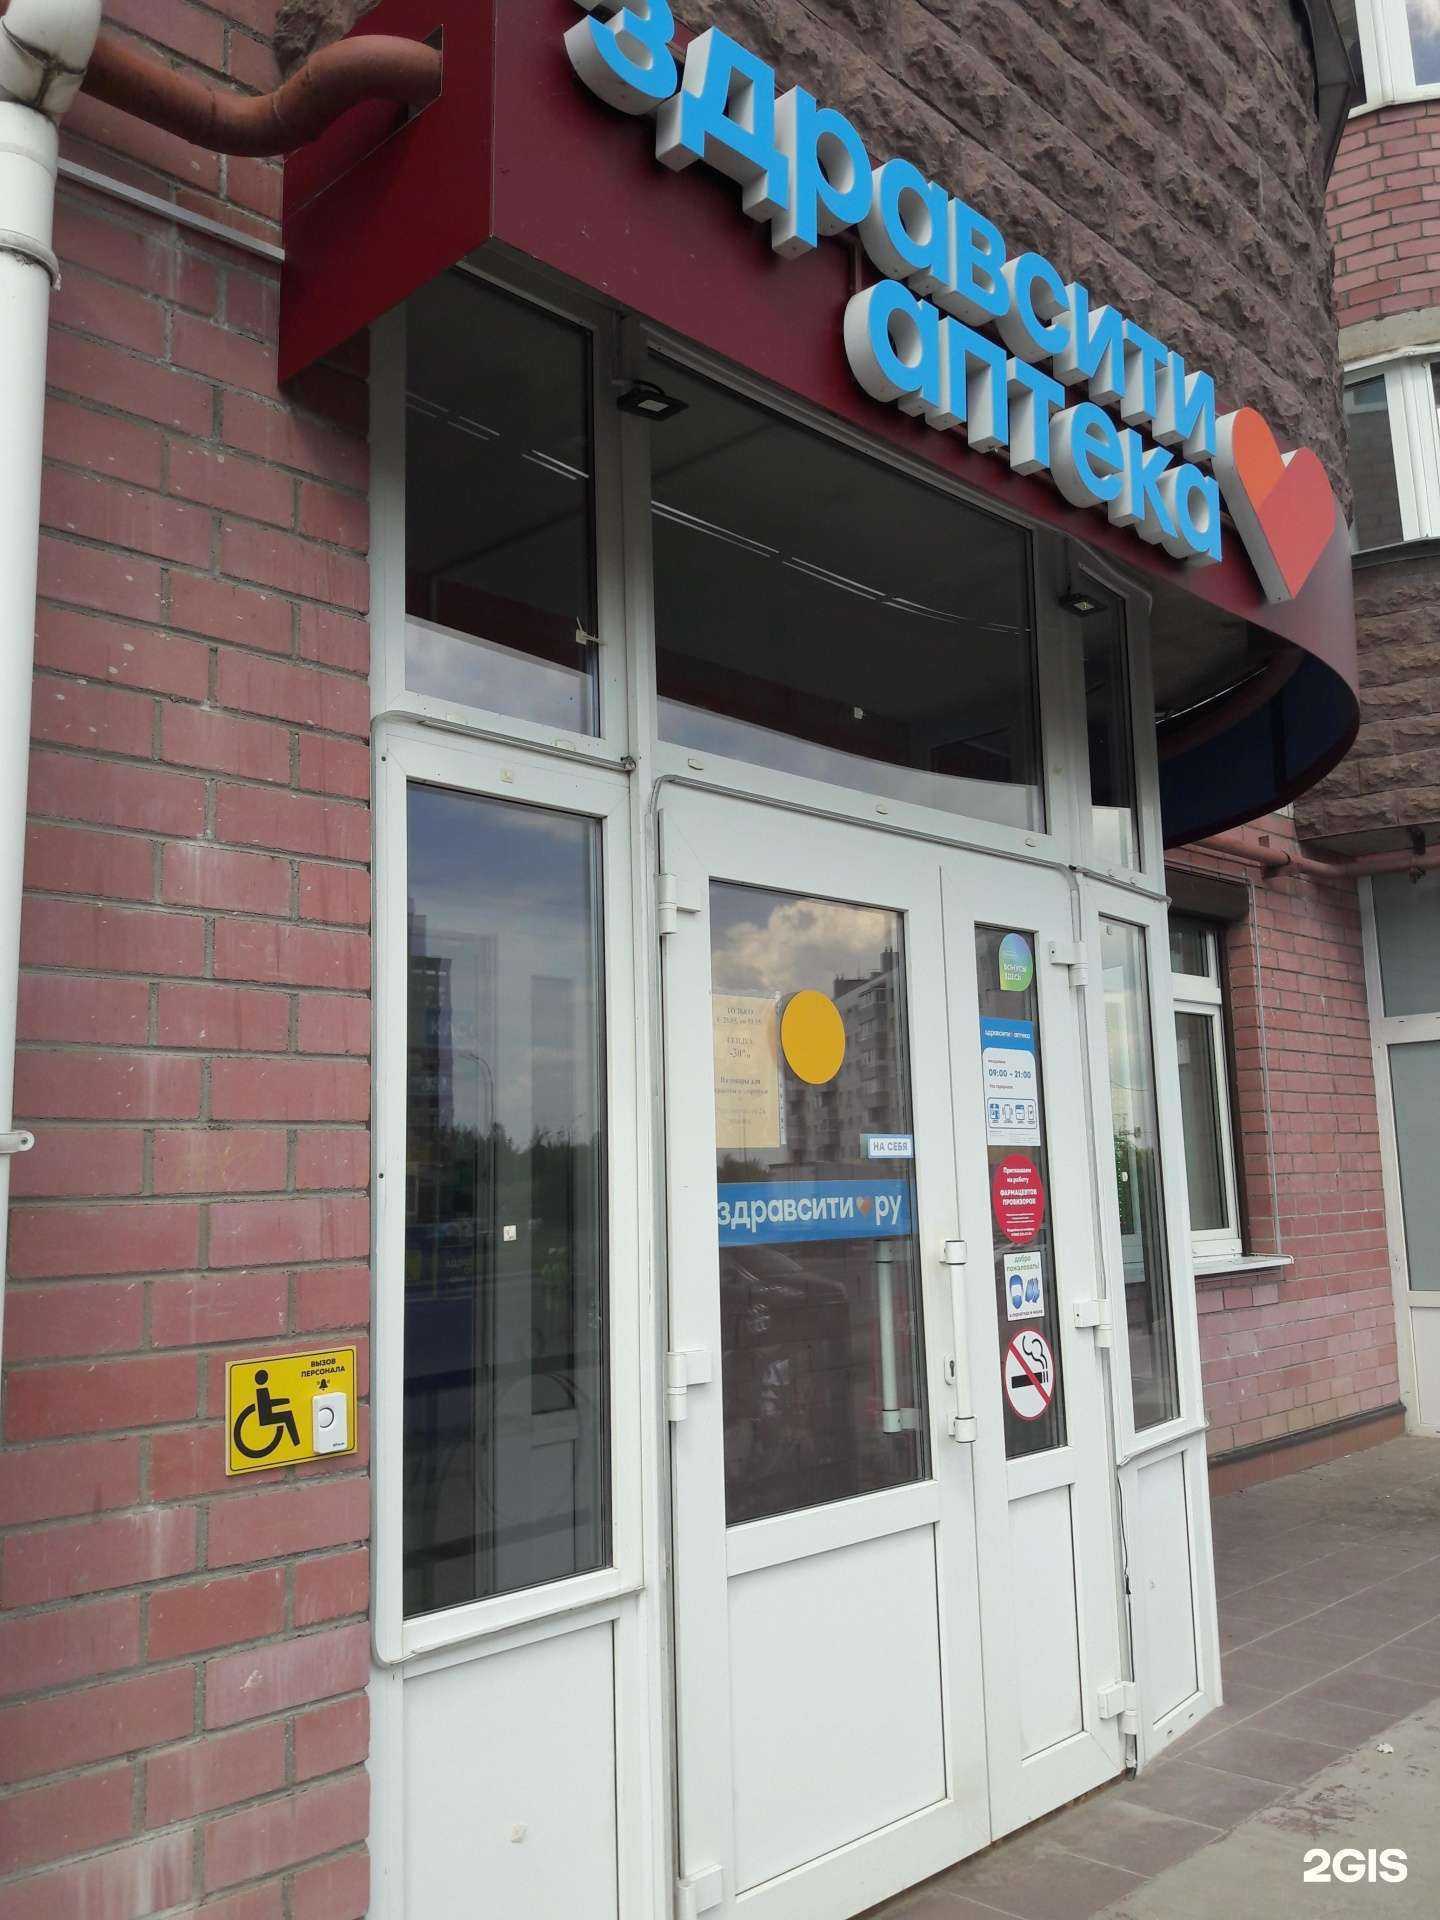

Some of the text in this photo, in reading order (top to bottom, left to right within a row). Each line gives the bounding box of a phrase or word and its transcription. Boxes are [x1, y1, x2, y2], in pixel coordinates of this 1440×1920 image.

[566, 0, 1217, 461] здравсити
[844, 278, 1223, 567] аптека
[988, 1068, 1008, 1078] 09:00
[1014, 1070, 1032, 1080] 21:00
[873, 1141, 908, 1151] НА СЕБЯ
[1002, 1198, 1036, 1206] ПРОВИЗОРОВ
[718, 1195, 902, 1233] здравсити ру
[310, 1358, 336, 1368] ВЫЗОВ
[301, 1366, 345, 1378] ПЕРСОНАЛА
